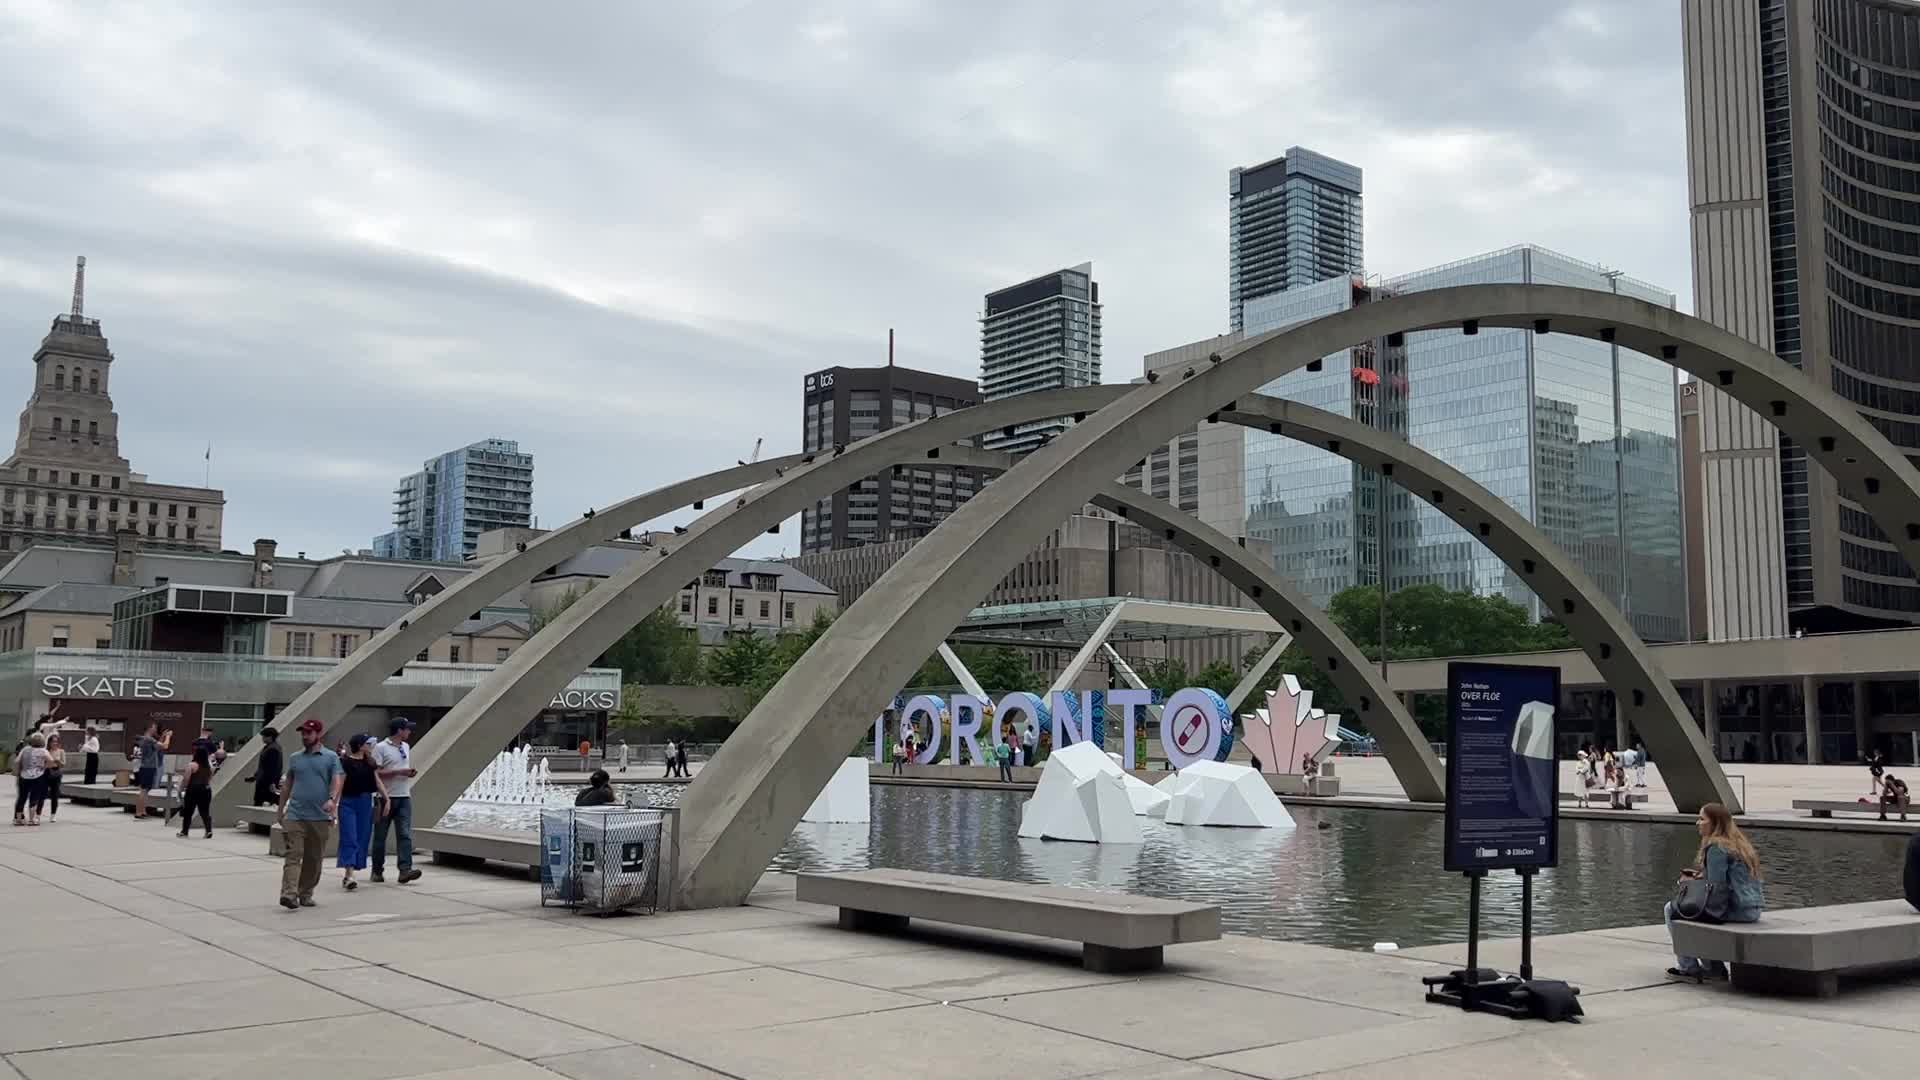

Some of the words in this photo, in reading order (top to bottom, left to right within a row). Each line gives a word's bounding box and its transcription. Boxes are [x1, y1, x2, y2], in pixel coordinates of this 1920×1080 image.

[42, 675, 175, 698] SKATES
[1460, 691, 1480, 700] OVER
[1482, 692, 1501, 701] FLOE
